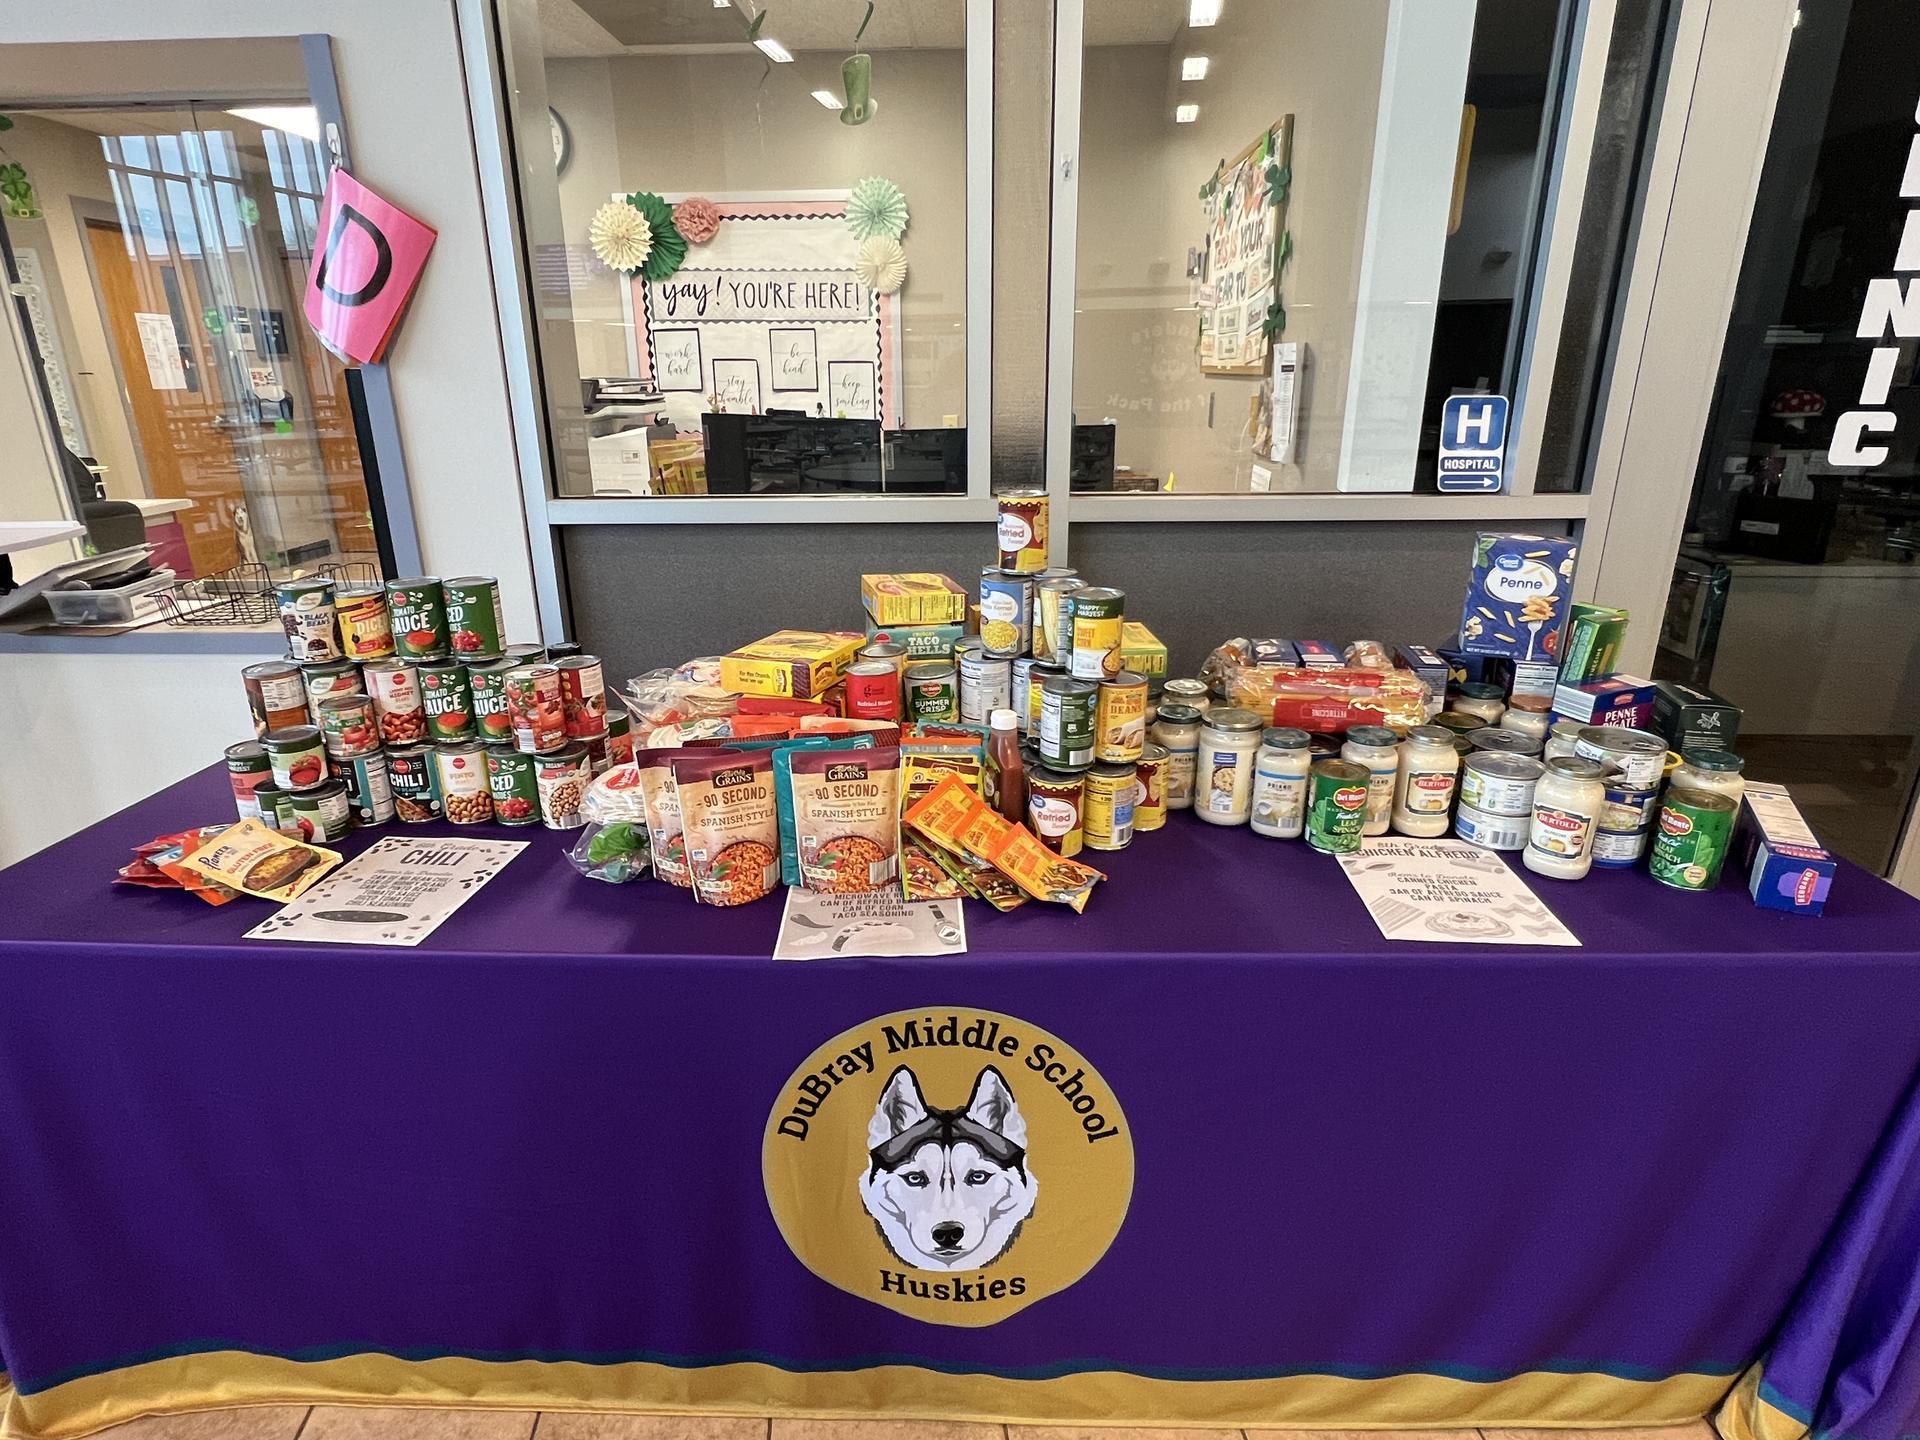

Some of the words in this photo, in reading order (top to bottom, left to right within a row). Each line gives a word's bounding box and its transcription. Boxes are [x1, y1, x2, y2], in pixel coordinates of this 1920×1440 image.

[316, 203, 392, 307] D
[1828, 95, 1920, 466] INIC
[662, 275, 722, 316] yay!
[729, 281, 797, 309] YOU'RE
[805, 282, 860, 311] HERE!
[667, 359, 691, 376] hard
[782, 357, 807, 375] kind
[726, 375, 746, 391] stay
[841, 374, 862, 397] keep
[1456, 404, 1493, 444] H
[1444, 459, 1496, 469] HOSPITAL
[1500, 577, 1543, 589] Penne
[304, 612, 329, 621] BLACK
[393, 605, 415, 617] TOMATO
[446, 606, 464, 623] CED
[306, 619, 330, 628] BEANS
[357, 618, 383, 634] DICE
[392, 611, 431, 634] AUCE
[907, 636, 940, 646] TACO
[907, 643, 951, 655] HELLS
[425, 688, 448, 699] TOMATO
[473, 689, 493, 699] TOMATO
[424, 693, 462, 715] AUCE
[473, 695, 508, 716] AUCE
[915, 699, 950, 708] SUMMER
[919, 705, 946, 713] CRISP
[1311, 708, 1347, 718] FETTUCCINE
[1604, 707, 1638, 722] PENNE
[389, 773, 424, 787] CHILI
[449, 772, 475, 780] PINTO
[715, 773, 753, 786] GRAINS
[828, 768, 866, 780] GRAINS
[491, 774, 514, 791] CED
[1418, 780, 1452, 788] BERTOLLI
[703, 794, 719, 808] 90
[722, 786, 767, 805] SECOND
[815, 787, 830, 800] 90
[833, 784, 879, 798] SECOND
[660, 802, 679, 812] SPAN
[811, 809, 854, 818] SPANISH
[856, 807, 888, 818] STYLE
[700, 814, 744, 827] SPANISH
[745, 808, 775, 820] STYLE
[1037, 810, 1071, 822] Refried
[1538, 813, 1579, 830] BERTOLLI
[1667, 816, 1690, 830] Monte
[198, 845, 231, 871] PIONEER
[400, 849, 469, 867] CHILI
[1356, 849, 1415, 858] CHICKEN
[1419, 850, 1480, 859] ALFREDO
[226, 851, 254, 875] GLUTEN
[777, 1040, 876, 1142] DuBray
[880, 1016, 1020, 1058] Middle
[1024, 1043, 1120, 1144] School
[879, 1269, 1027, 1302] Huskies
